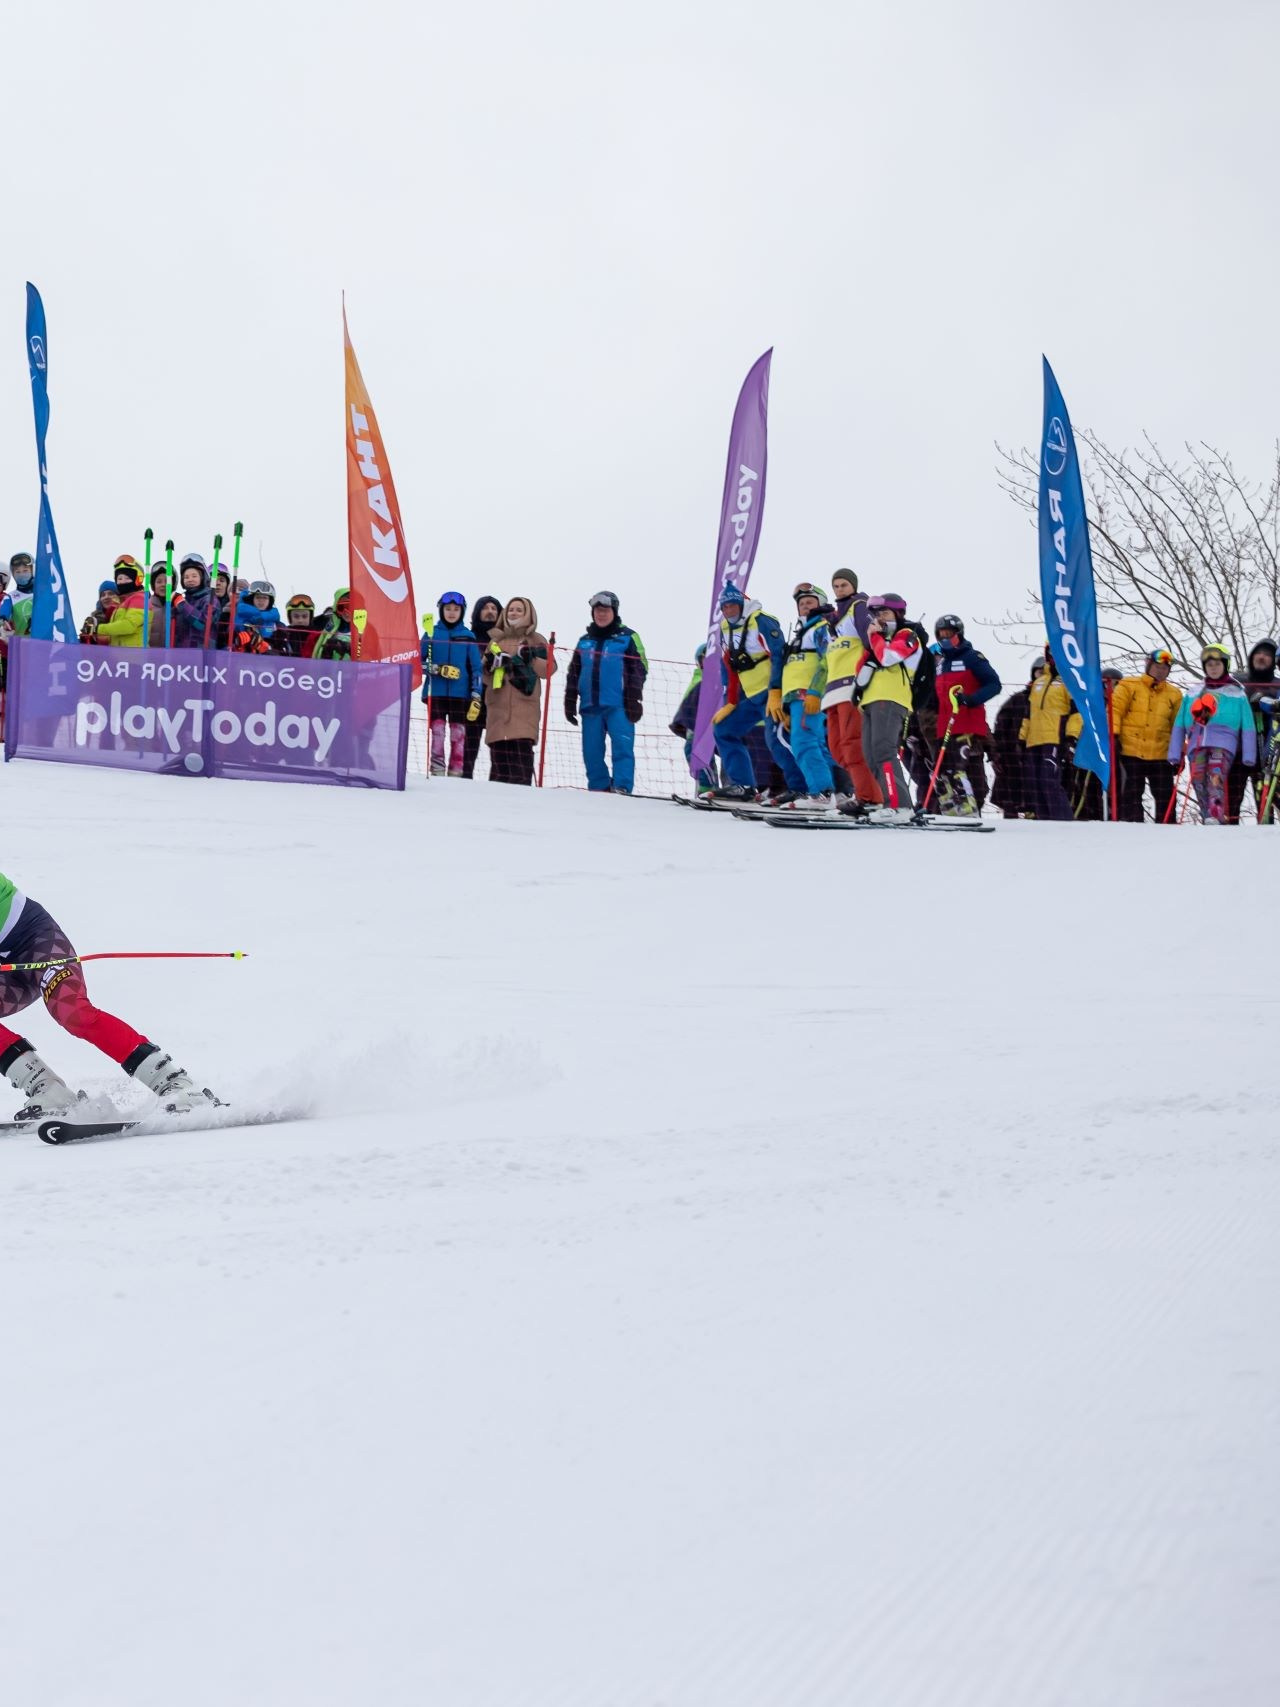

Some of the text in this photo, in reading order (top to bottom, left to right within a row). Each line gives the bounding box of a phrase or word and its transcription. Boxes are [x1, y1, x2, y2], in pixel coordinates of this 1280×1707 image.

[350, 403, 401, 569] КАНТ
[76, 659, 343, 699] для ярких побед!
[75, 691, 341, 763] playToday
